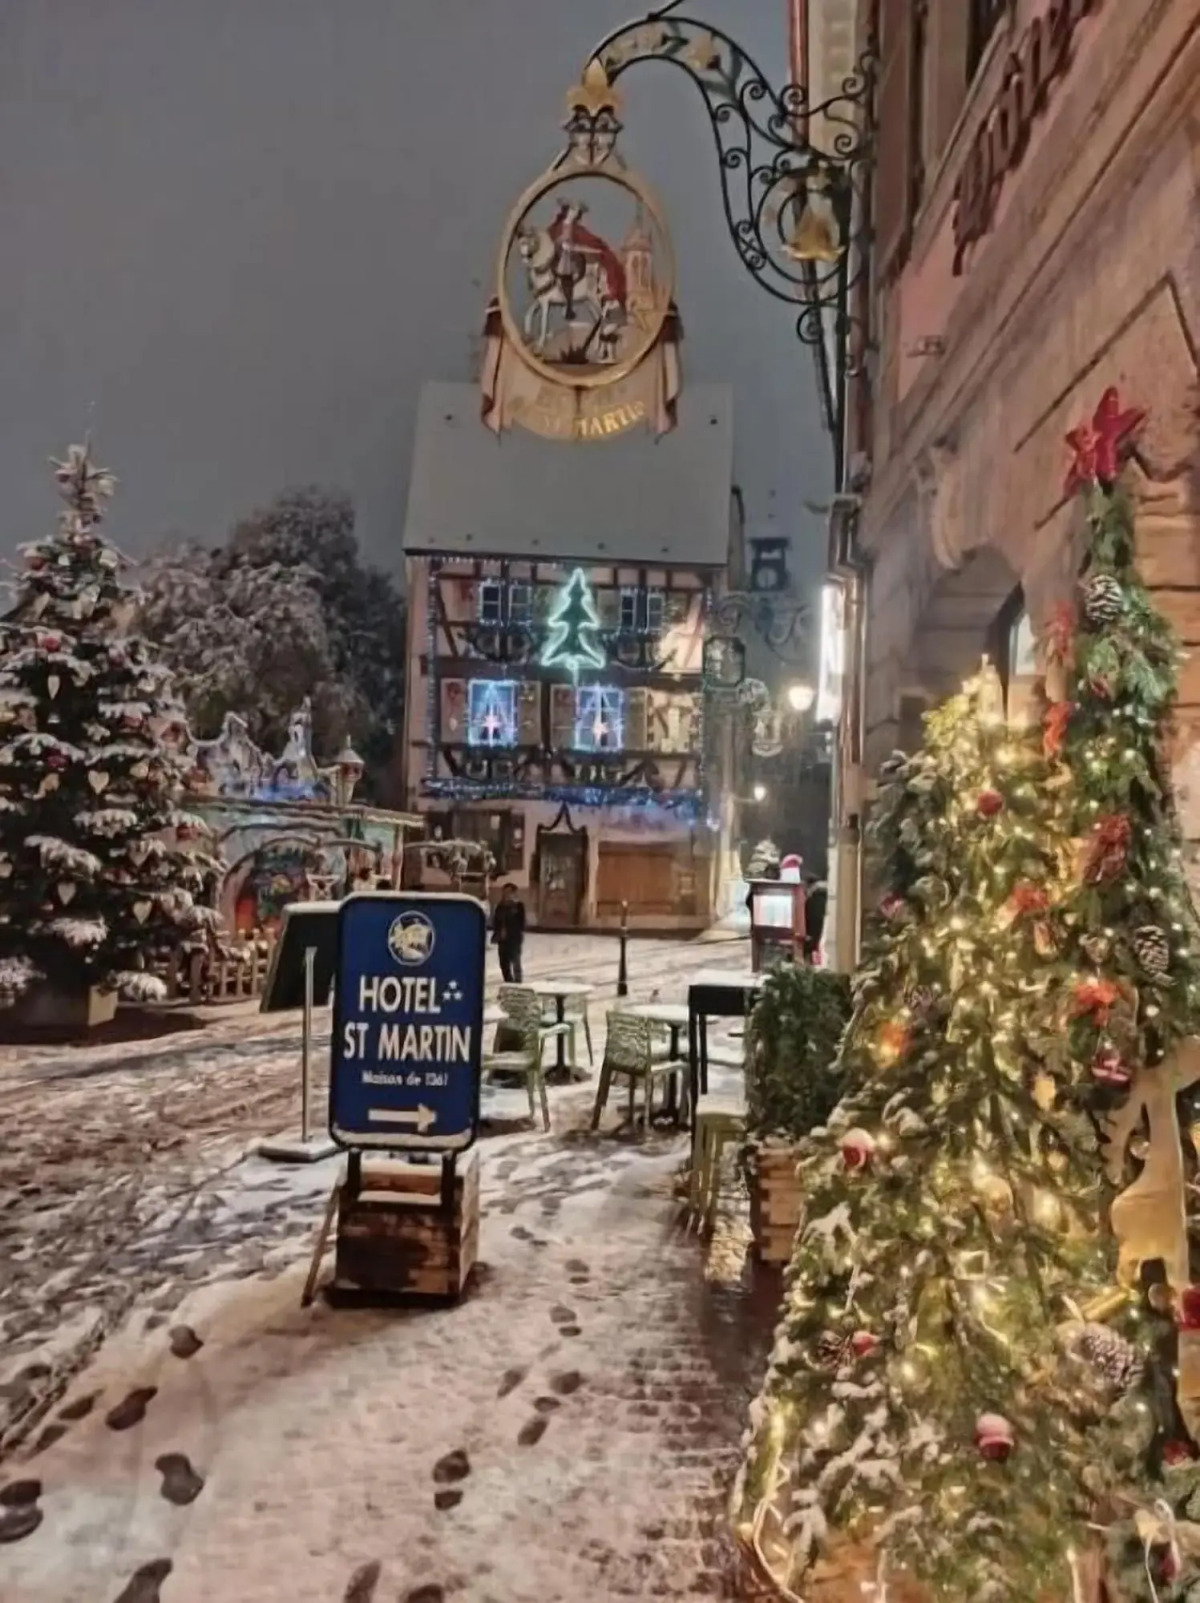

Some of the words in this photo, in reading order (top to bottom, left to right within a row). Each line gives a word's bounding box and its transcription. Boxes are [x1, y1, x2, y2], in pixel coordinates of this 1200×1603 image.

[358, 974, 441, 1014] HOTEL
[343, 1021, 369, 1059] ST
[378, 1022, 471, 1063] MARTIN
[362, 1069, 402, 1085] Maison
[406, 1070, 422, 1086] de
